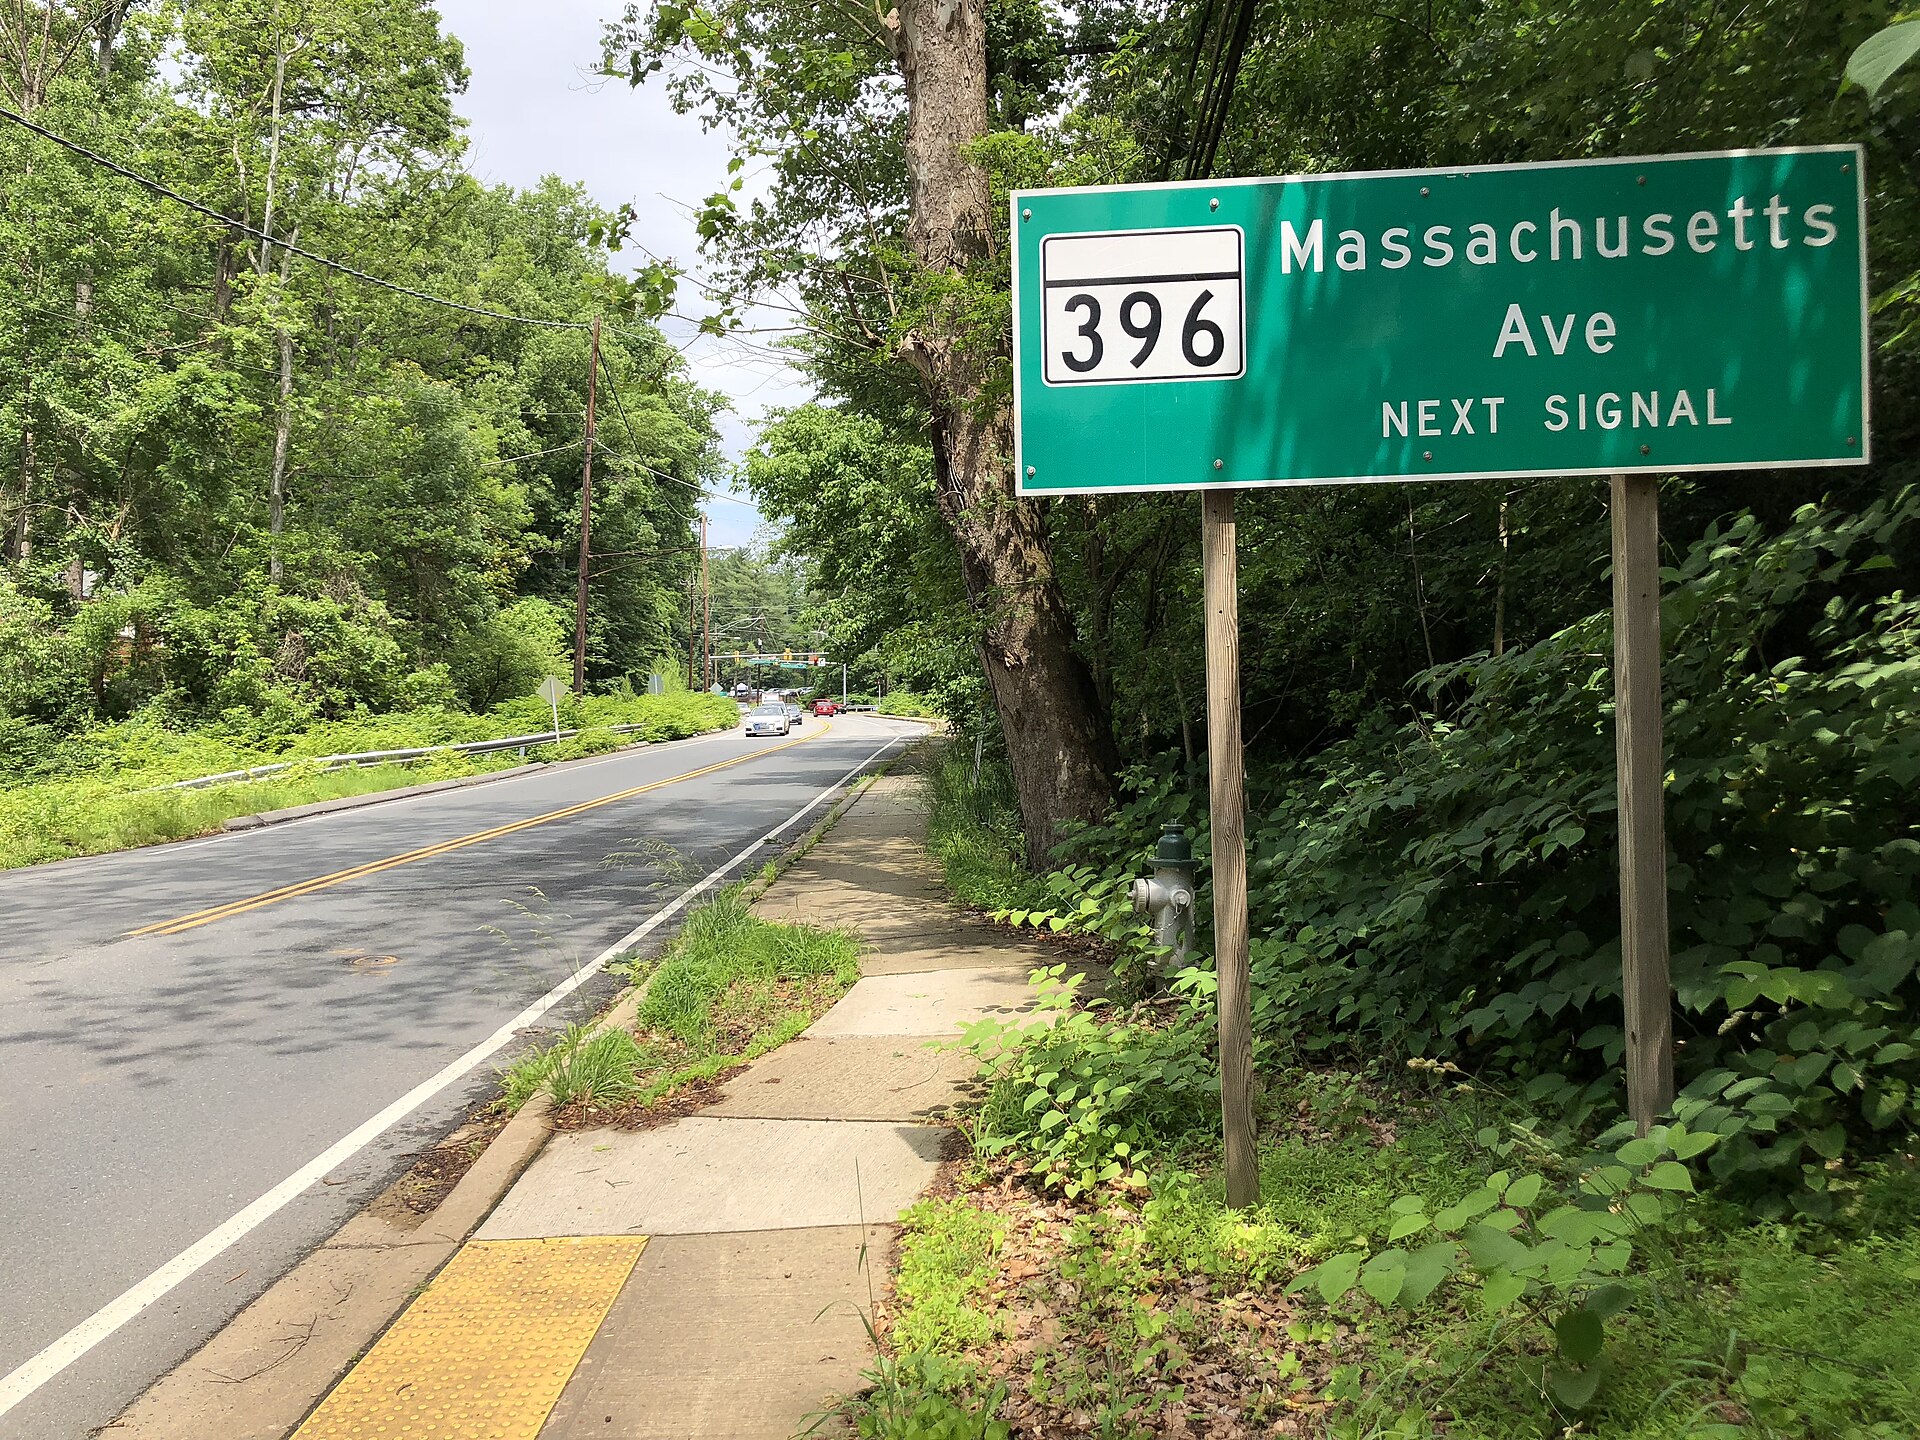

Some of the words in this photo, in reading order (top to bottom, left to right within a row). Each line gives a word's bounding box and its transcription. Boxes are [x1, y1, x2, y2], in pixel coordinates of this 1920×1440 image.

[1280, 195, 1838, 274] Massachusetts
[1062, 289, 1225, 372] 396
[1493, 303, 1617, 358] Ave
[1381, 398, 1505, 438] NEXT
[1544, 388, 1733, 431] SIGNAL
